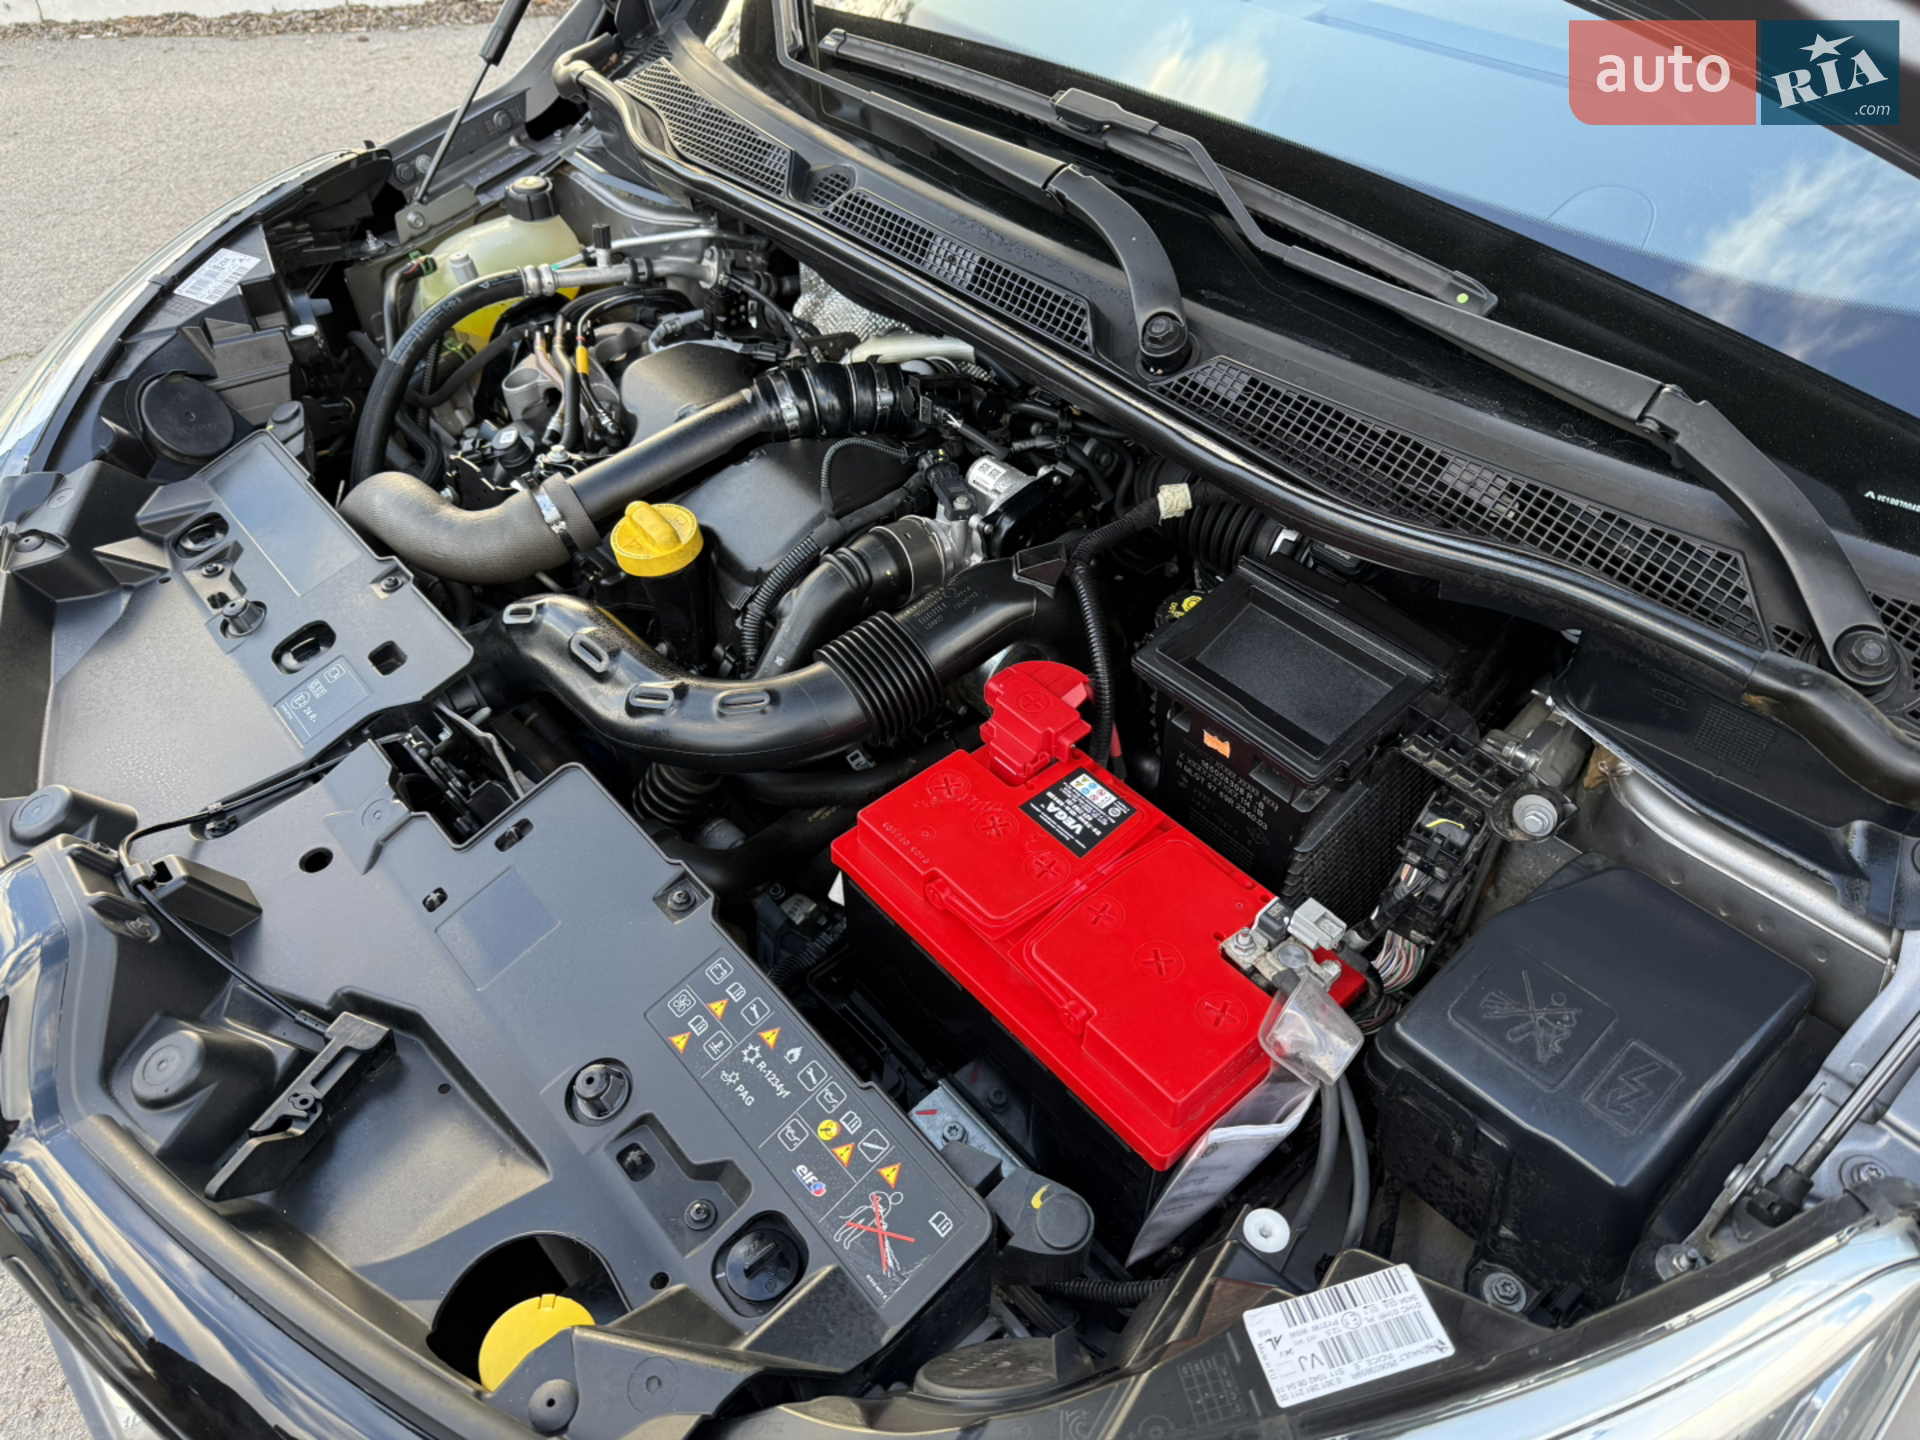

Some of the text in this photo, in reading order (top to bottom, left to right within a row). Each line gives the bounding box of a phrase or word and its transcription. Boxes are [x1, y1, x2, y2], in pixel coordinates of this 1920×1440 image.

[1046, 801, 1083, 835] VEGA
[756, 1060, 791, 1099] R-1234yf
[735, 1085, 756, 1107] PAG
[795, 1163, 818, 1185] elf
[1295, 1350, 1325, 1372] VJ
